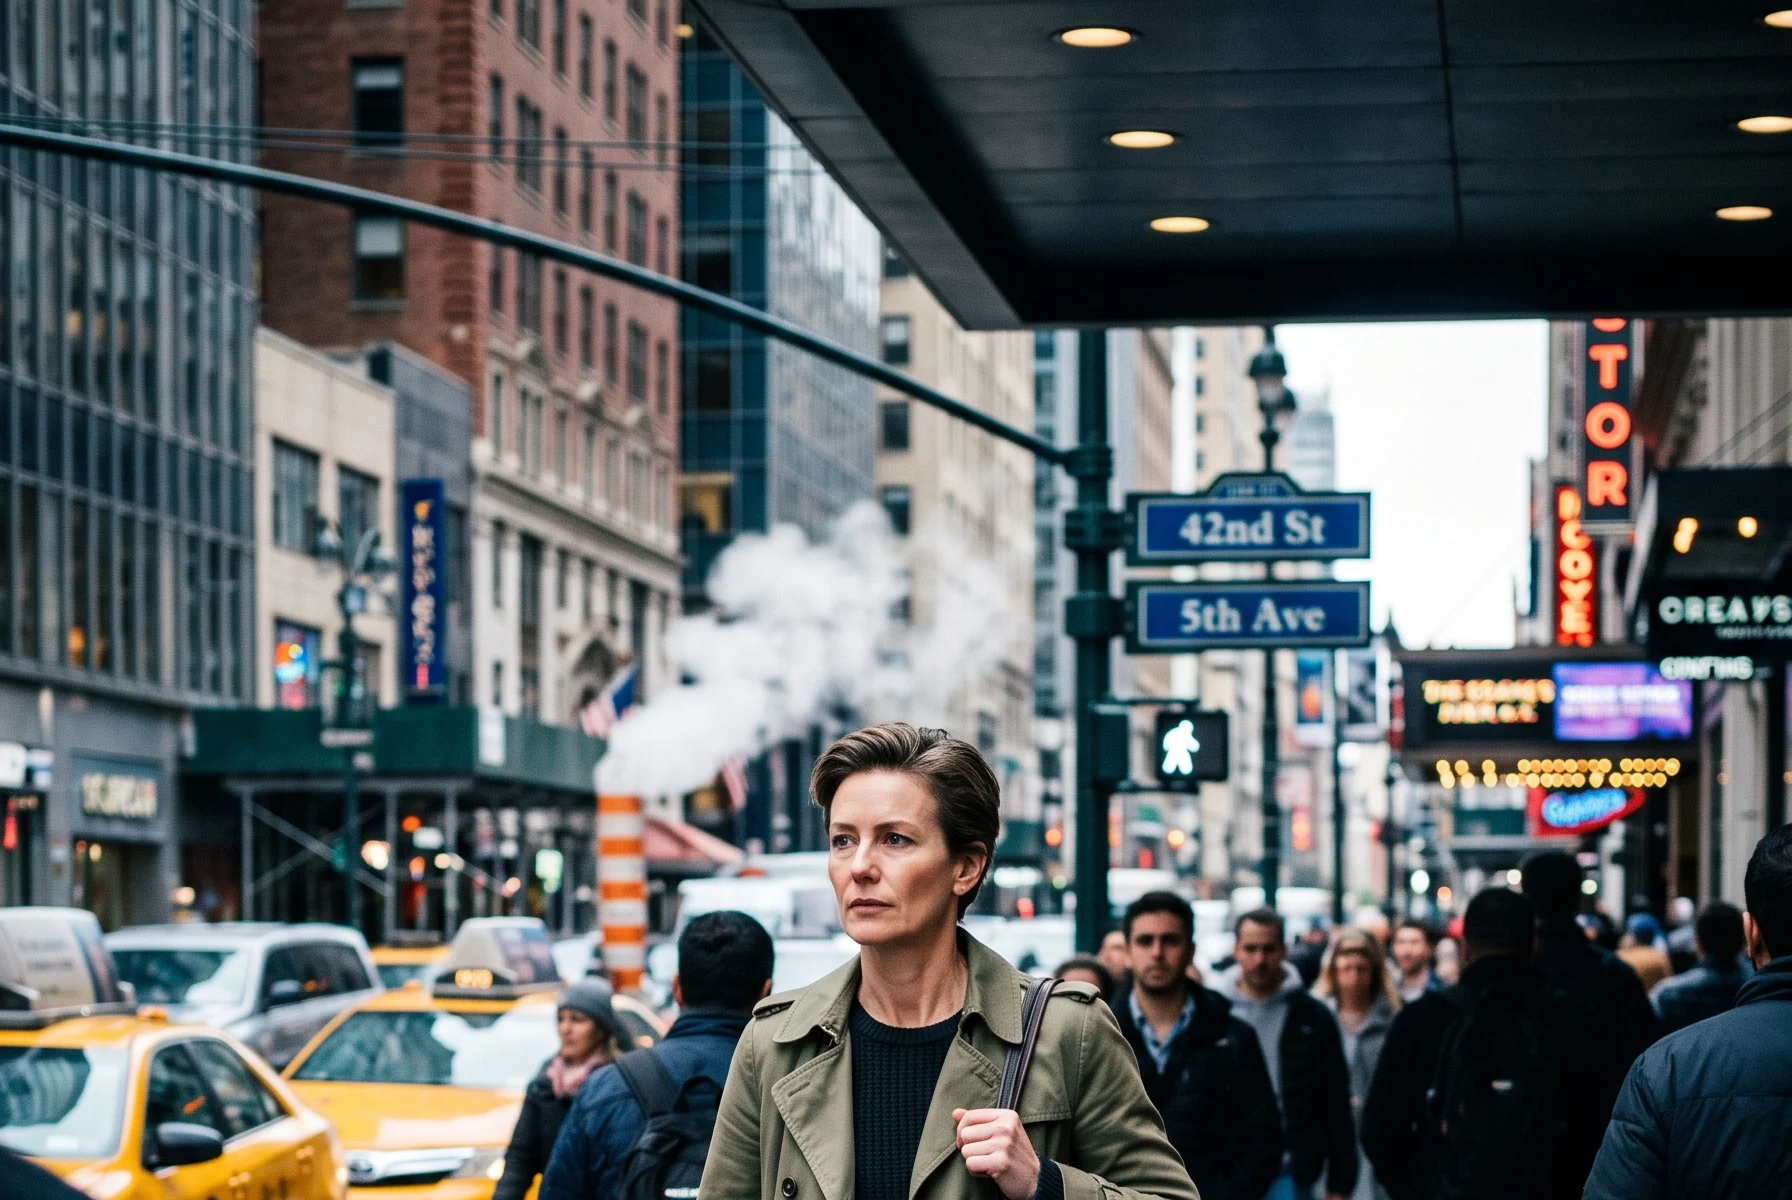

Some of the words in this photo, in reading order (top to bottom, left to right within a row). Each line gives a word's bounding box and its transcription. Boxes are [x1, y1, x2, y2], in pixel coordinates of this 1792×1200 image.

[1179, 510, 1275, 546] 42nd
[1284, 510, 1326, 546] St
[1180, 598, 1242, 634] 5th
[1252, 598, 1327, 632] Ave
